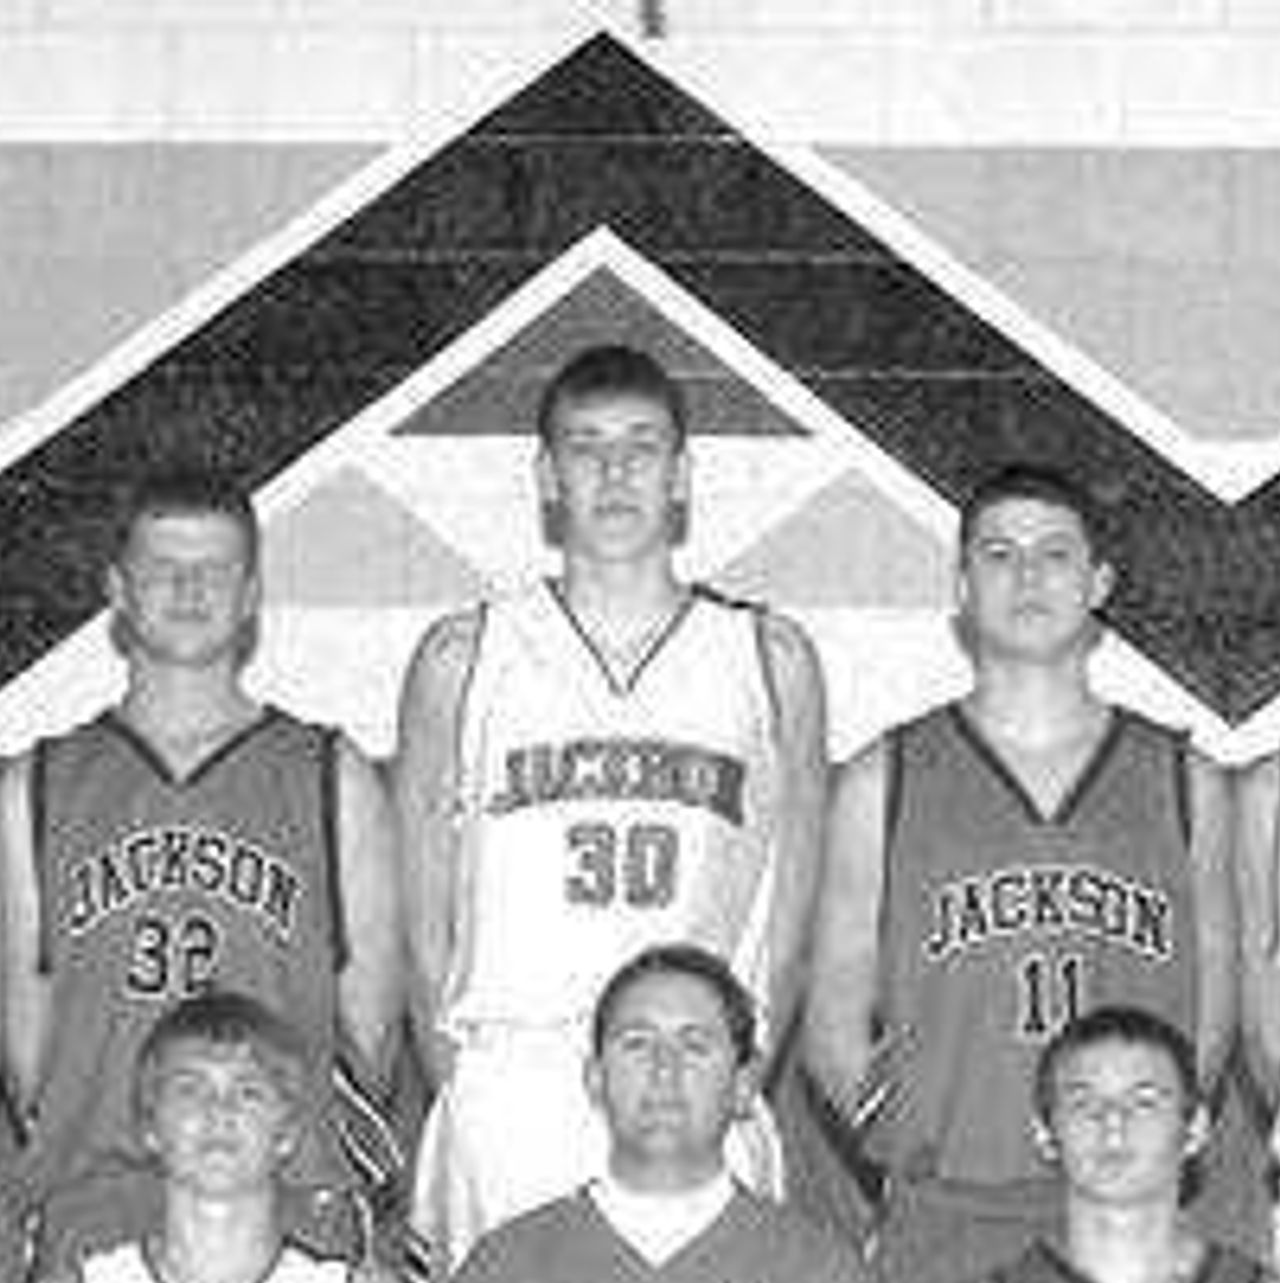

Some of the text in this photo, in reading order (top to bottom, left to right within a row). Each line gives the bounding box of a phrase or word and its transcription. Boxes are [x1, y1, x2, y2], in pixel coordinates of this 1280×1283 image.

[64, 822, 305, 940] JACKSON
[565, 823, 678, 908] 30
[925, 867, 1172, 959] JACKSON
[125, 914, 222, 998] 32
[1019, 954, 1082, 1037] 11
